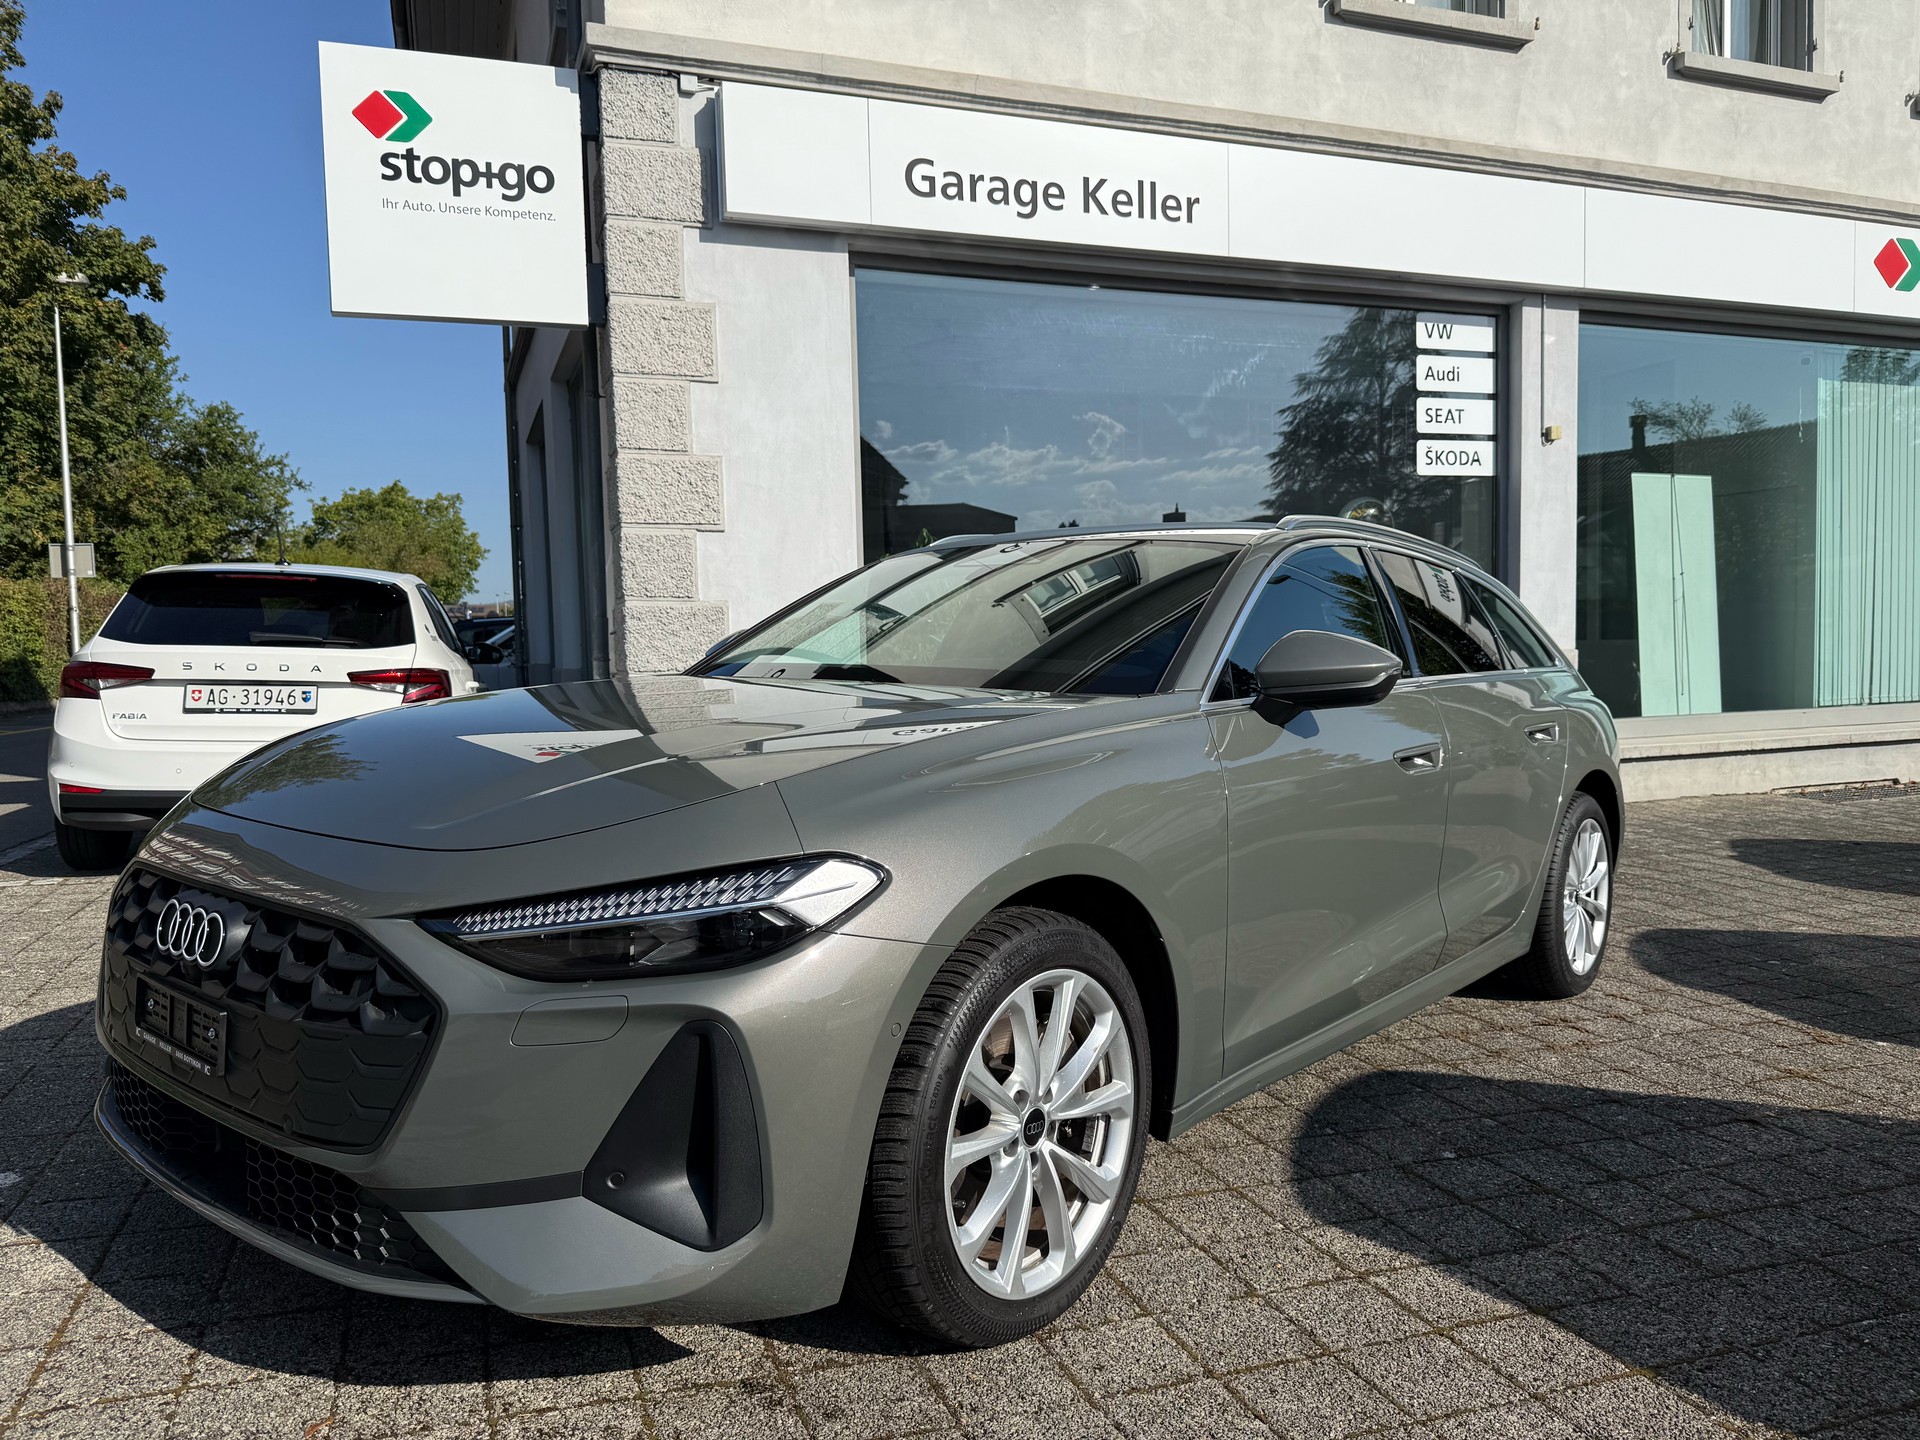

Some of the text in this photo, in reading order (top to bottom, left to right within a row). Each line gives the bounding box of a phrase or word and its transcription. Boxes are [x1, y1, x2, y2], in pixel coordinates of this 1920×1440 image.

[380, 147, 556, 202] stop+go
[904, 157, 1200, 224] Garage Keller
[382, 197, 557, 222] Ihr Auto. Unsere Kompetenz.
[1424, 323, 1454, 340] VW
[1424, 365, 1461, 382] Audi
[1424, 407, 1465, 425] SEAT
[1425, 446, 1482, 467] ŠKODA
[112, 712, 148, 720] FABIA
[159, 1041, 172, 1053] KELLER
